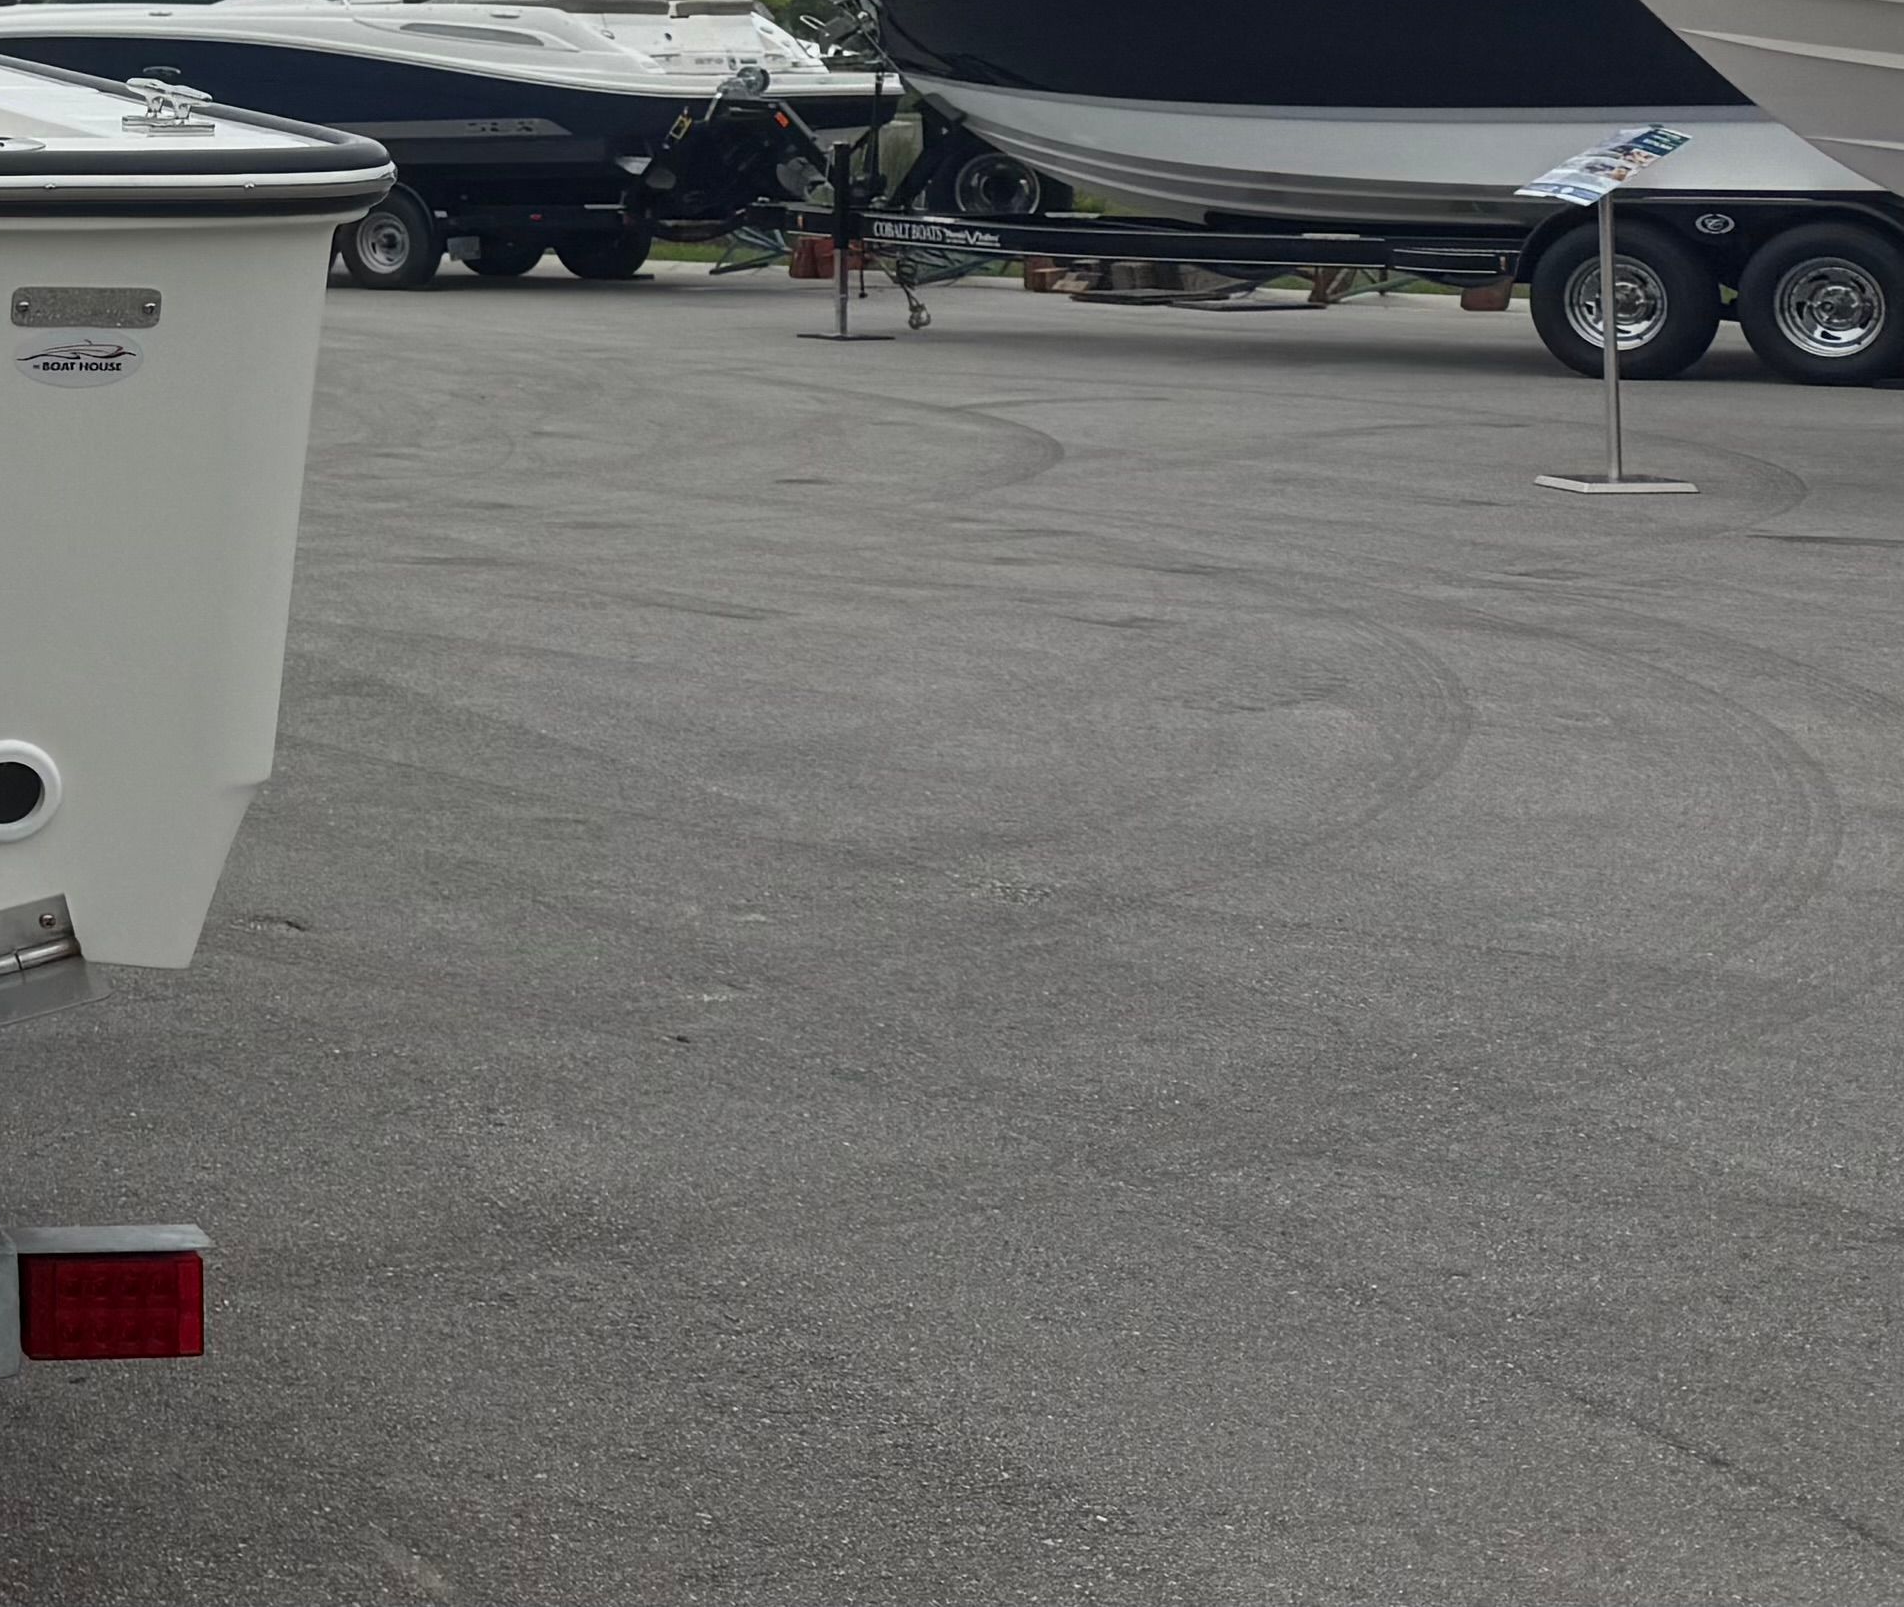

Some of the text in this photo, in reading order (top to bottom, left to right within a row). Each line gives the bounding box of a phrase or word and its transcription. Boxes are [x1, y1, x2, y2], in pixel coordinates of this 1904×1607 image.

[873, 221, 910, 239] COBALT
[911, 224, 943, 242] BOATS
[42, 361, 76, 371] BOAT
[79, 361, 122, 371] HOUSE
